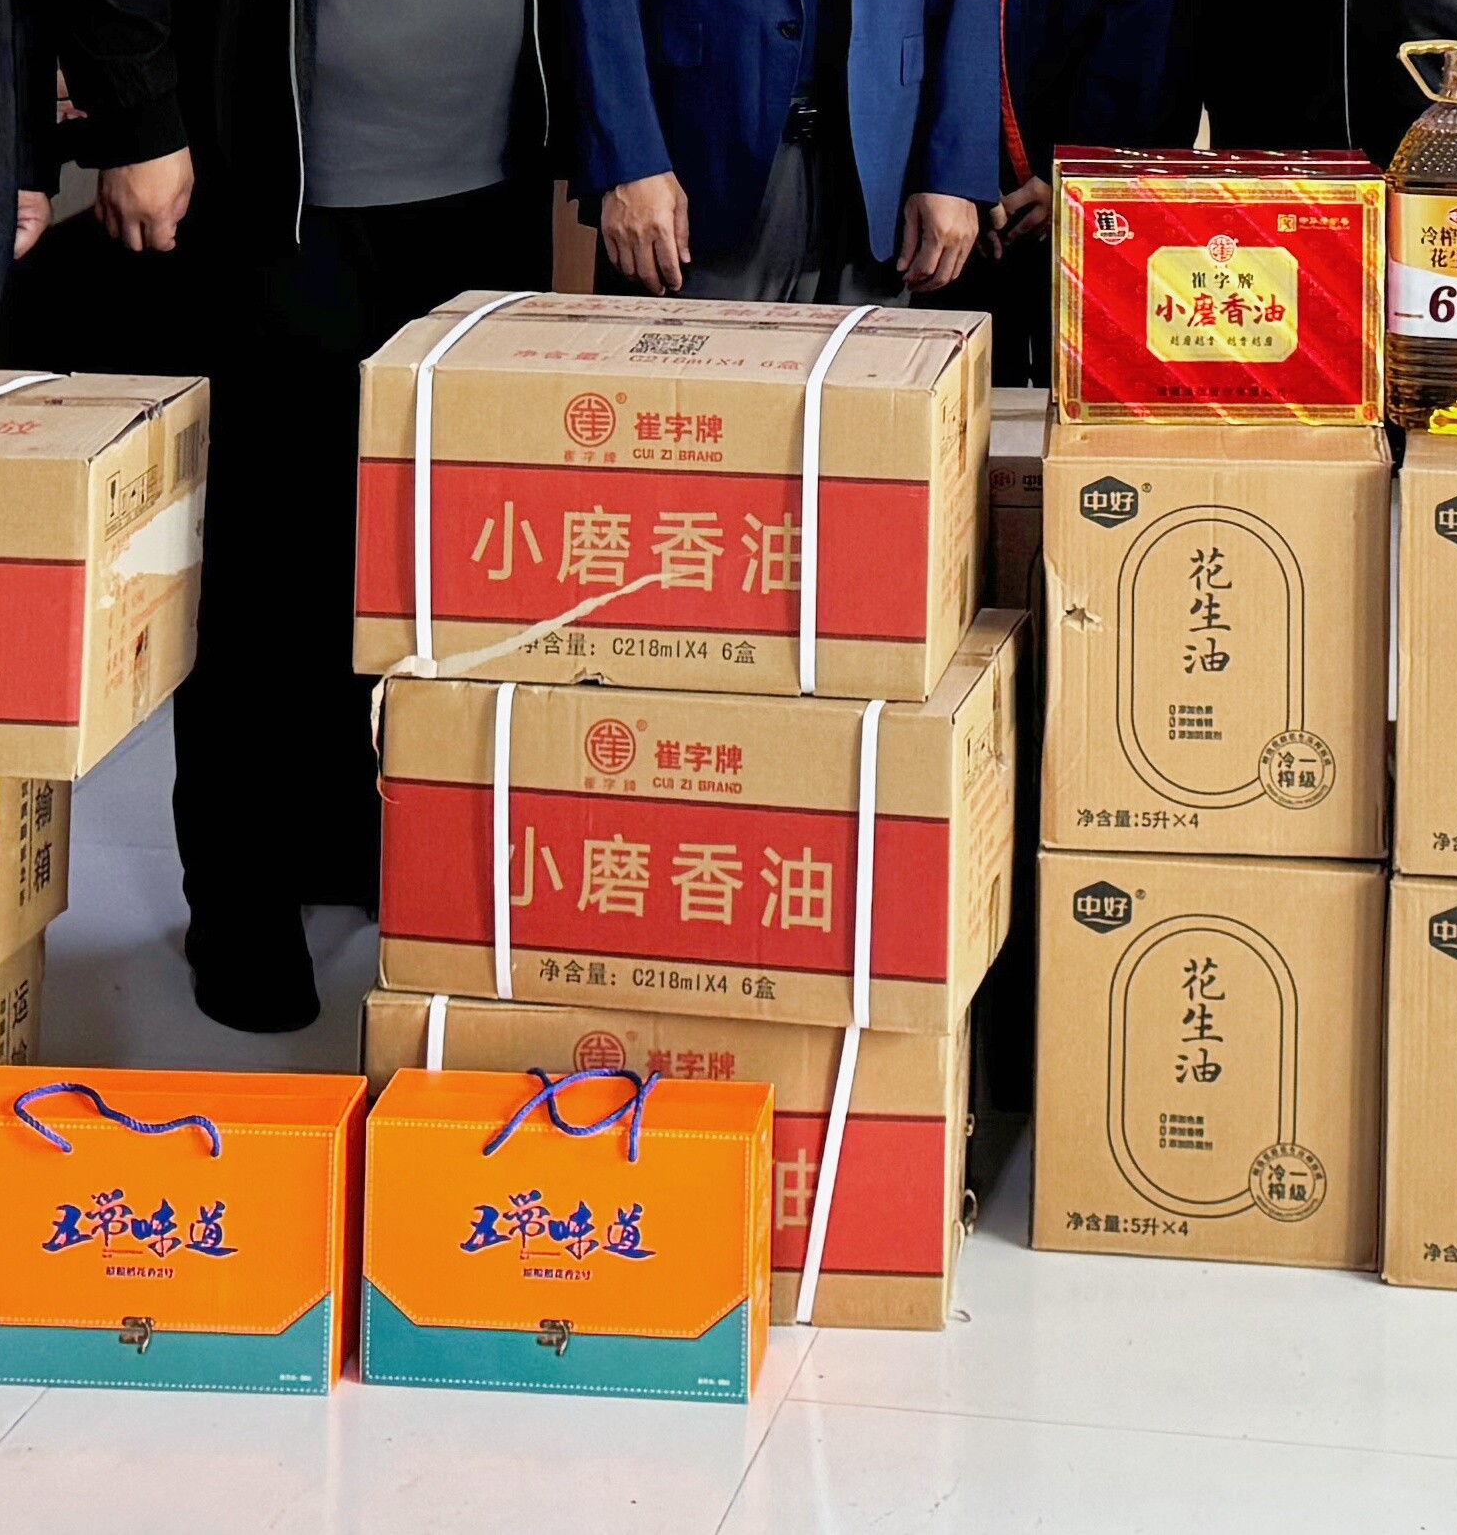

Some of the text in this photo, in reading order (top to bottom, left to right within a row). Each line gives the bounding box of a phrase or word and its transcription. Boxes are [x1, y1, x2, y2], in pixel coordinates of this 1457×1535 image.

[1155, 292, 1287, 328] 小磨香油
[633, 412, 724, 445] 崔字牌
[633, 448, 723, 463] CUI ZI BRAND
[1083, 492, 1135, 512] 中好
[470, 500, 804, 594] 小磨香油
[1183, 547, 1232, 674] 花生油
[653, 740, 743, 777] 崔字牌
[652, 775, 743, 795] CUI ZI BRAND
[508, 826, 835, 934] 小磨香油
[1077, 895, 1128, 917] 中好
[1175, 958, 1225, 1084] 花生油
[647, 1049, 736, 1081] 崔字牌
[41, 1188, 239, 1259] 五常味道
[459, 1189, 658, 1262] 五常味道
